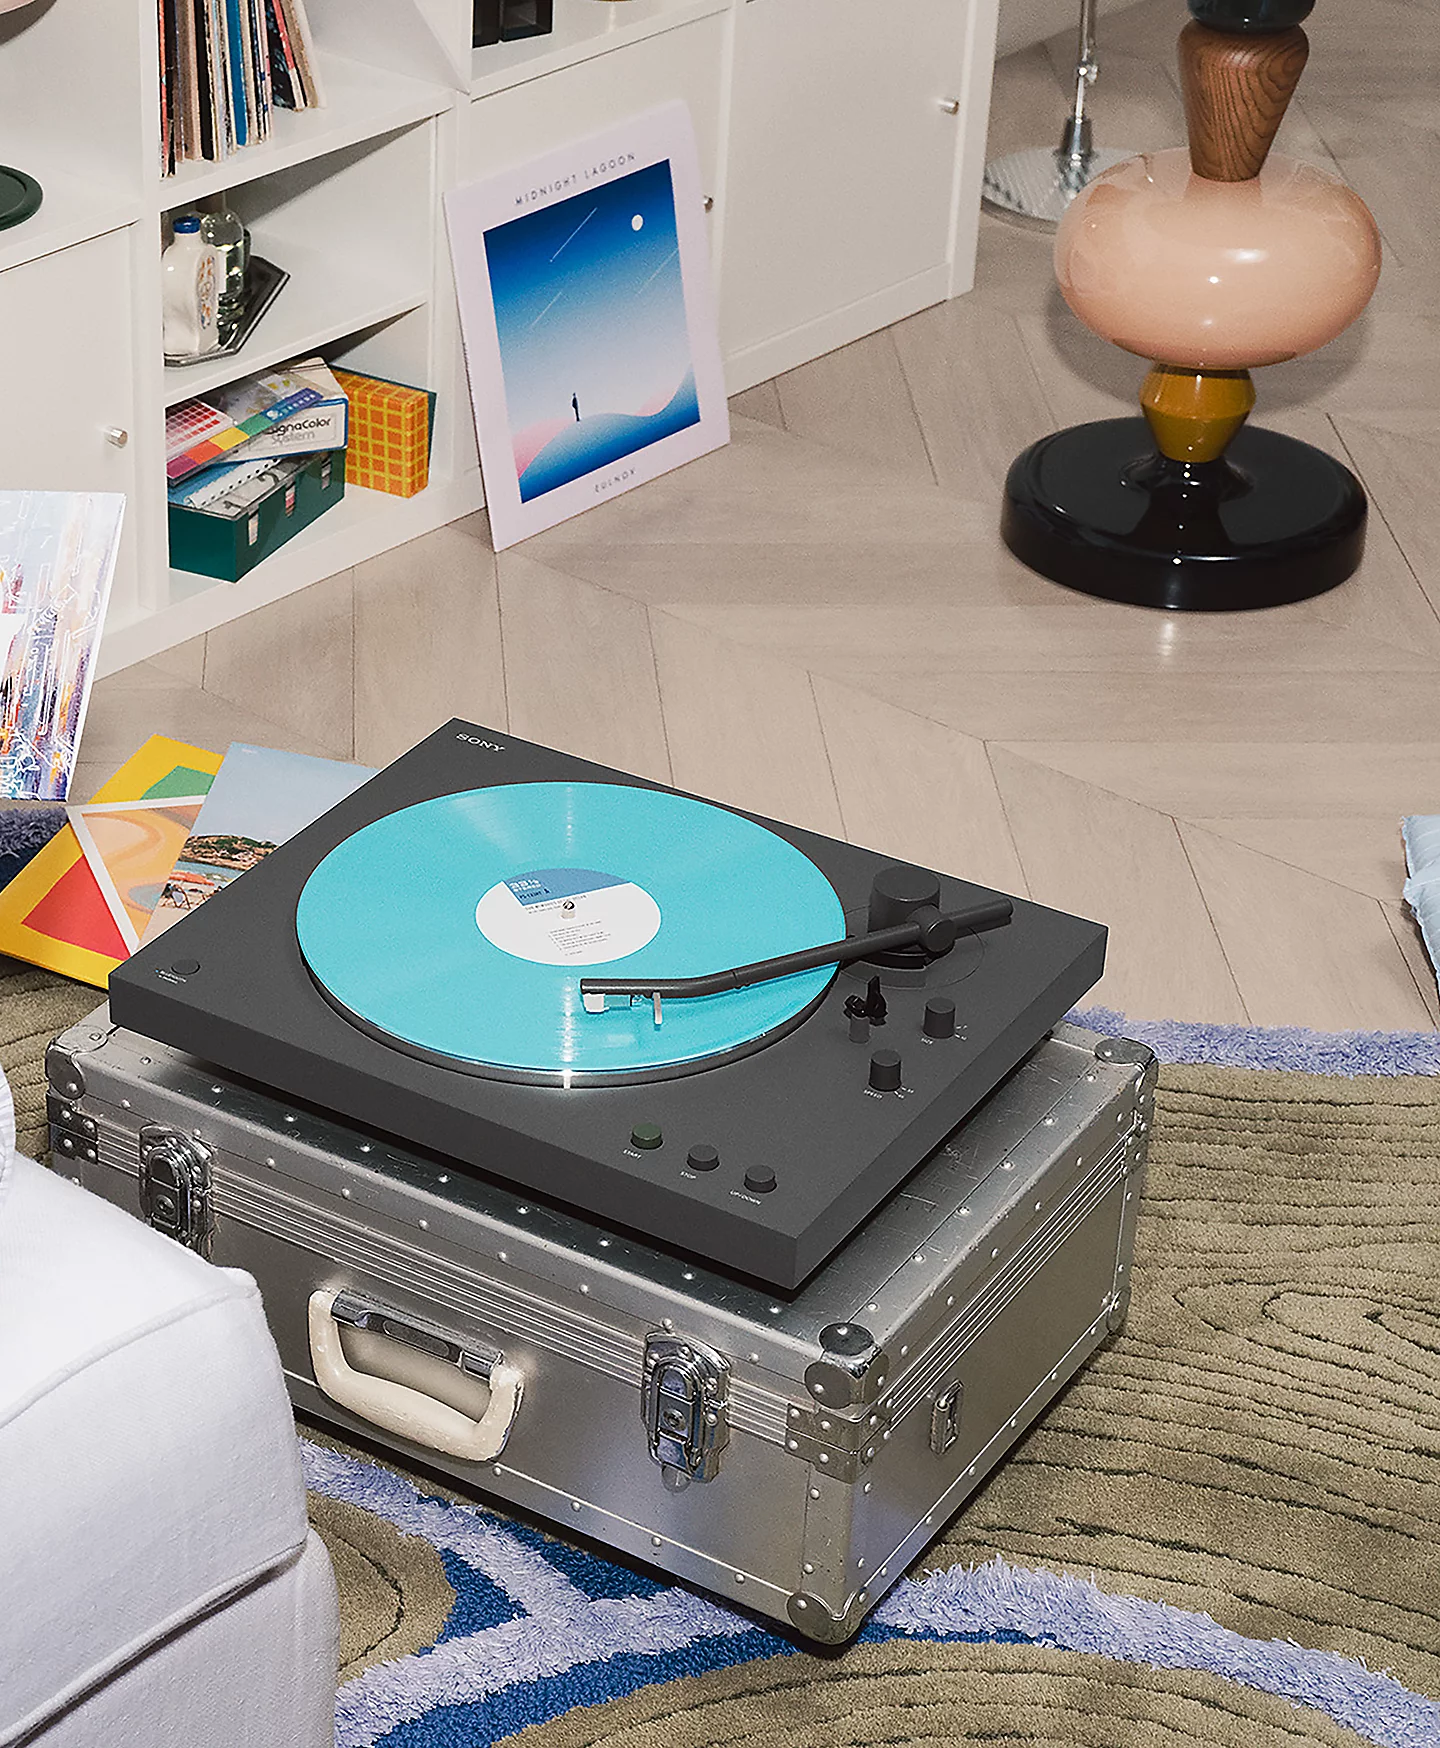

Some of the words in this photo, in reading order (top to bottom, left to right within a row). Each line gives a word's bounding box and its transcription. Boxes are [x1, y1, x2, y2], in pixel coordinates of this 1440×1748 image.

[515, 173, 577, 205] MIDNIGHT
[584, 153, 636, 179] LAGOON
[272, 430, 315, 445] System
[455, 733, 506, 752] SONY
[863, 1088, 883, 1099] SPEED
[623, 1149, 642, 1160] START
[680, 1170, 697, 1179] STOP
